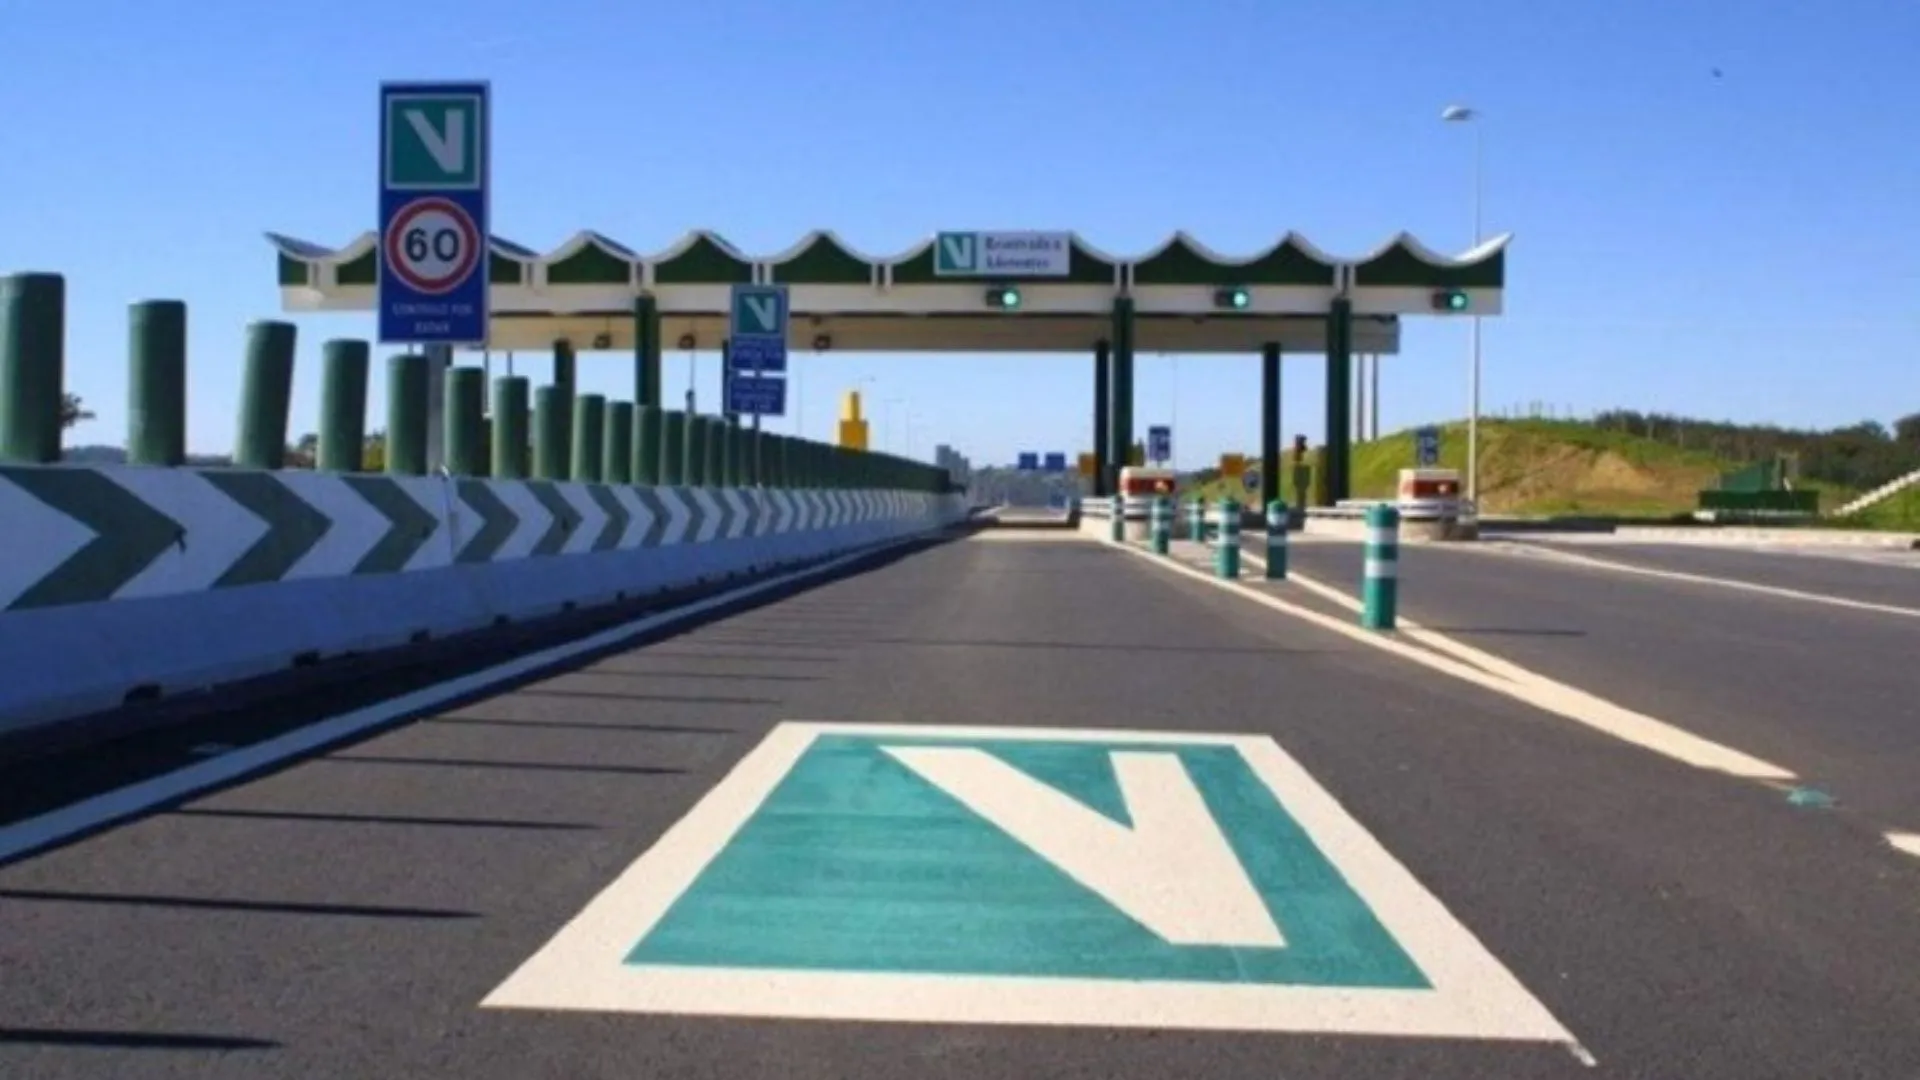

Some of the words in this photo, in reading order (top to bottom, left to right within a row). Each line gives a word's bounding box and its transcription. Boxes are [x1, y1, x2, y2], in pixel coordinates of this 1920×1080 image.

[404, 109, 465, 174] V
[406, 228, 459, 262] 60
[943, 236, 972, 268] V
[744, 296, 776, 331] V
[880, 746, 1287, 947] V
